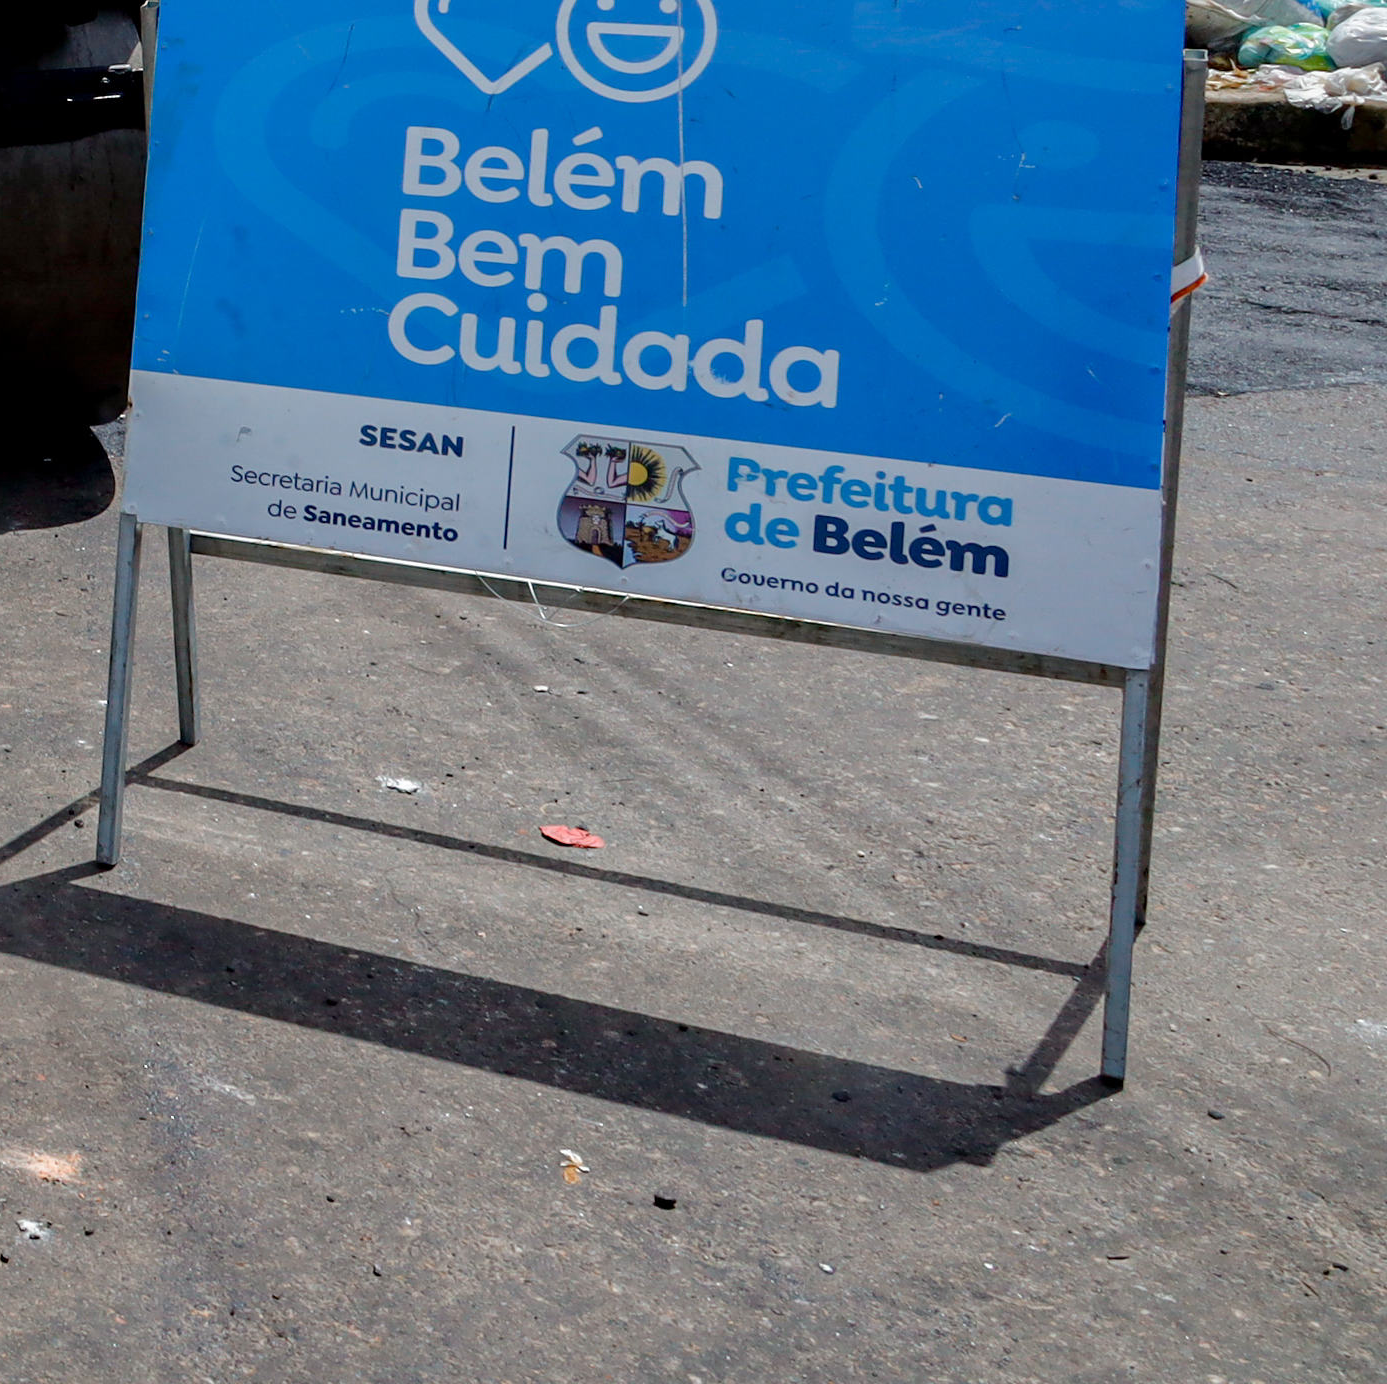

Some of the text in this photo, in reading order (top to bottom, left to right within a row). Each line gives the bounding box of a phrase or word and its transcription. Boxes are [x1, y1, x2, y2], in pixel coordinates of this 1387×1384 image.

[402, 125, 723, 220] Belém
[396, 208, 623, 298] Bem
[388, 291, 839, 409] Cuidada
[359, 424, 464, 457] SESAN
[230, 465, 460, 513] Secretaria Municipal
[267, 499, 458, 542] de Saneamento
[727, 456, 1013, 527] Prefeitura
[724, 502, 1010, 578] de Belém
[721, 566, 1007, 622] Governo da nossa gente
